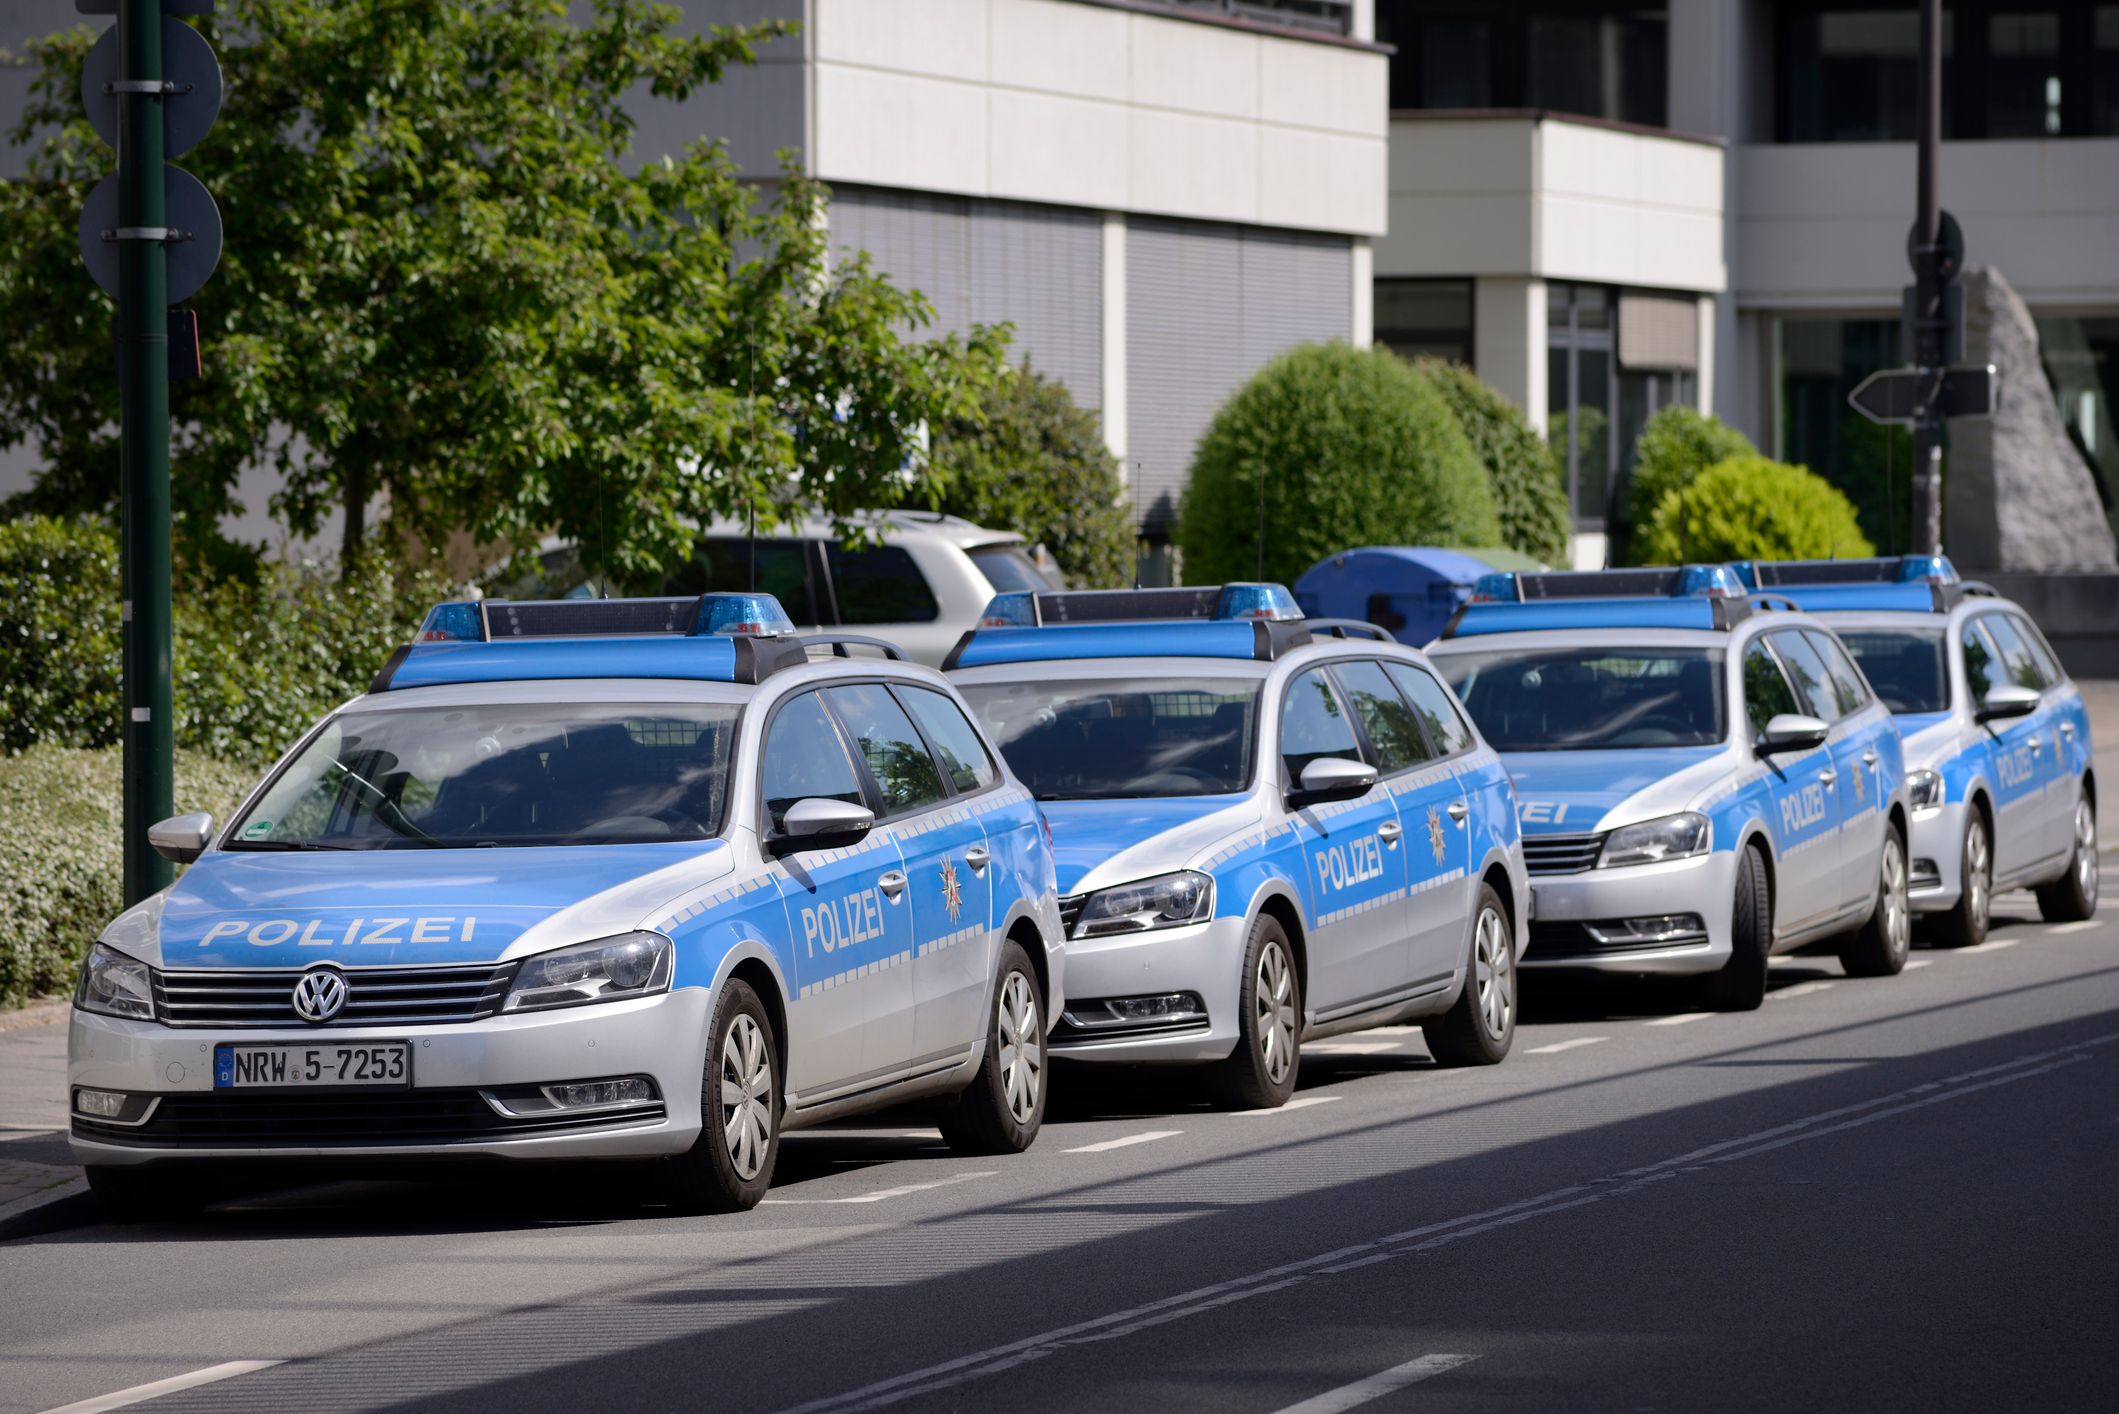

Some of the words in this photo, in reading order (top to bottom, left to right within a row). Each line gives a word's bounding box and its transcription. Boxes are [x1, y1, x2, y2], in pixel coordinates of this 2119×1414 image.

[1780, 783, 1825, 834] POLIZEI
[1315, 833, 1383, 895] POLIZEI
[198, 917, 476, 947] POLIZEI
[801, 887, 884, 958] POLIZEI
[296, 973, 343, 1018] VW
[221, 1072, 229, 1081] D
[235, 1052, 286, 1082] NRW
[305, 1048, 404, 1081] 5-7253
